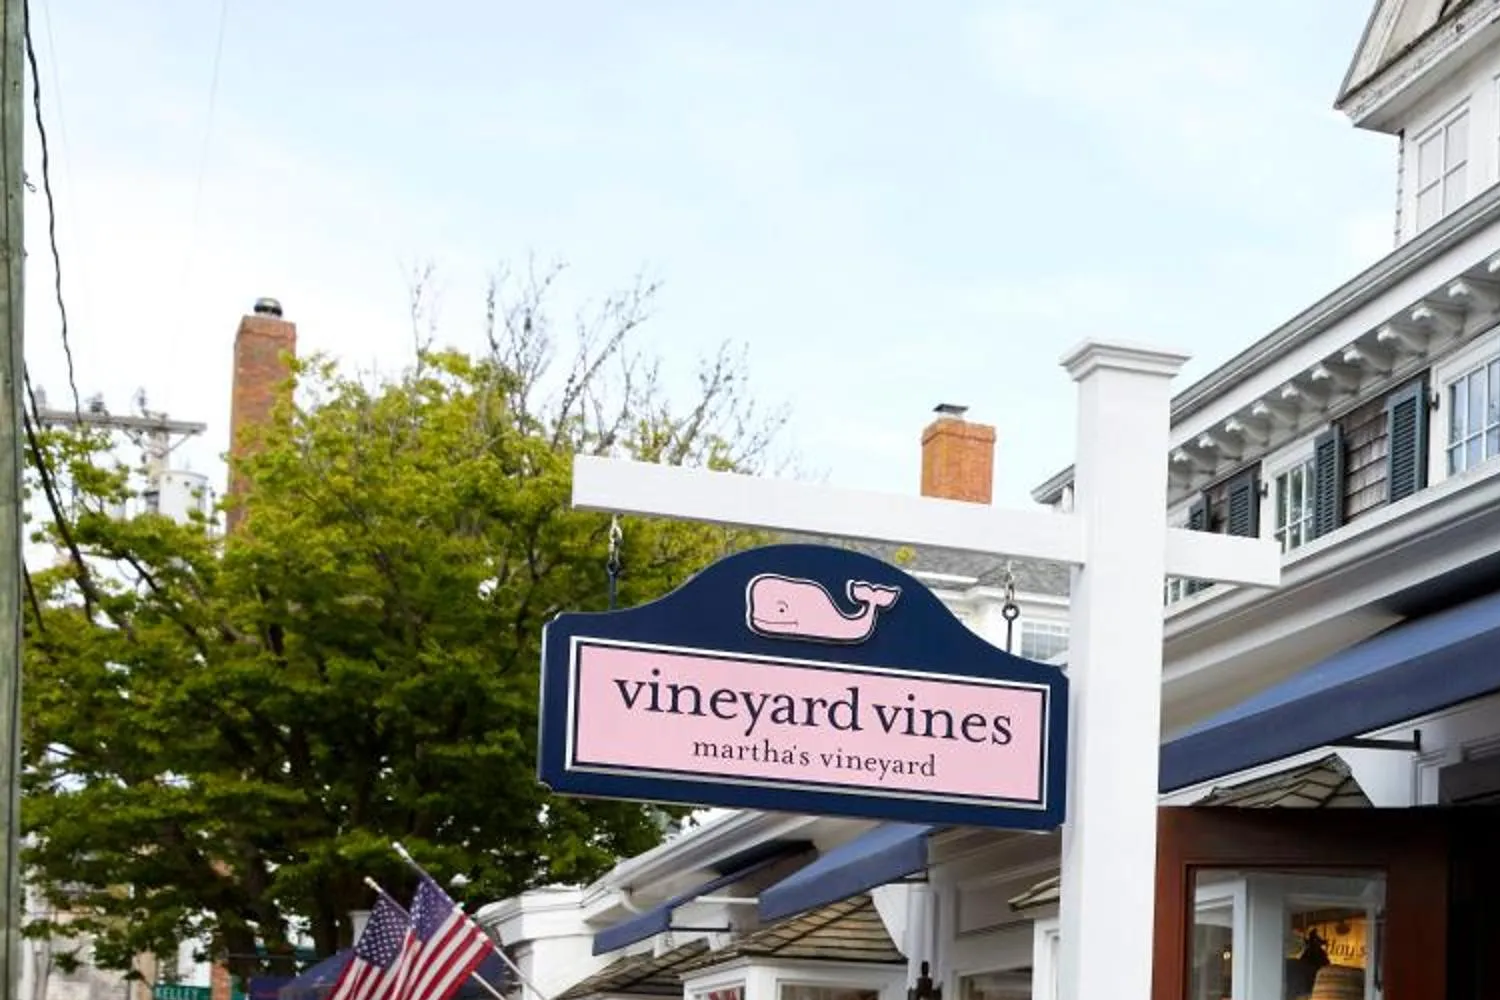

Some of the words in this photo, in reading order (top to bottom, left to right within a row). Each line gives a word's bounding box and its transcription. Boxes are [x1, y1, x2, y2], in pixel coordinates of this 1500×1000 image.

[612, 667, 864, 738] vineyard
[872, 692, 1014, 746] vines
[693, 738, 810, 767] martha's
[820, 750, 936, 780] vineyard
